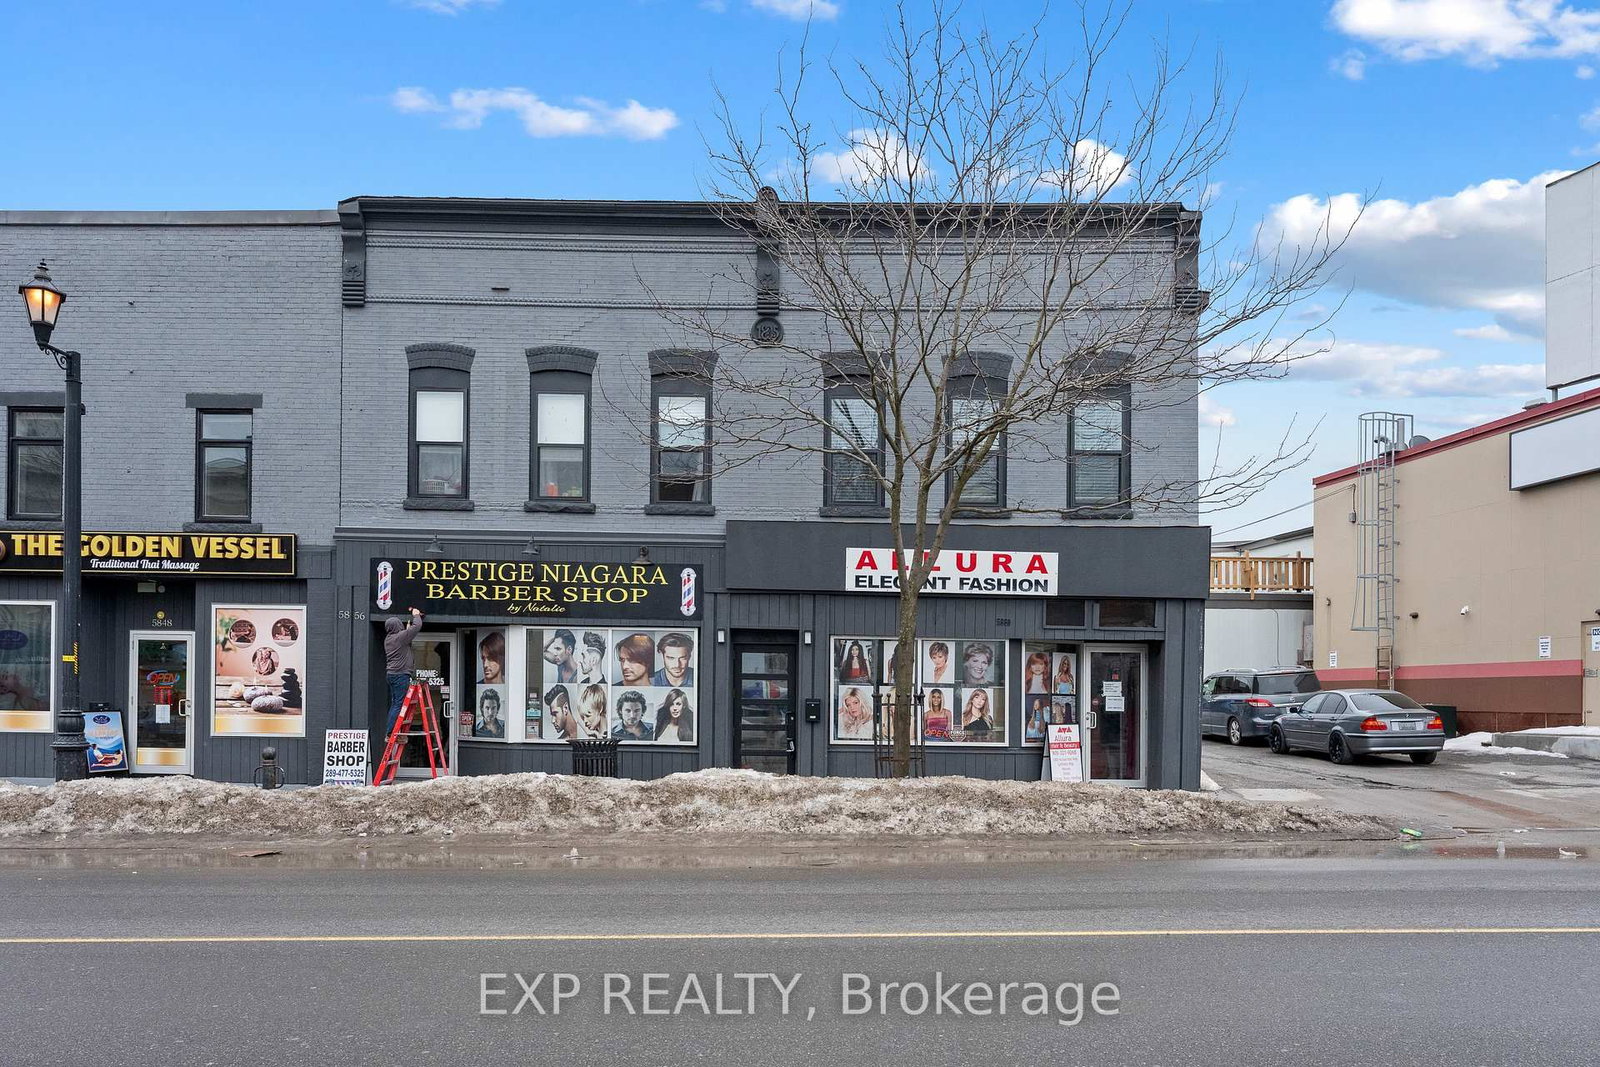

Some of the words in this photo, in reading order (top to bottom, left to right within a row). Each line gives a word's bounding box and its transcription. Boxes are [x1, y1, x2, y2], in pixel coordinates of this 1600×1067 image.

[11, 534, 64, 556] THE
[81, 534, 182, 558] GOLDEN
[191, 536, 287, 559] VESSEL
[90, 558, 139, 569] Traditional
[140, 559, 160, 570] Thai
[161, 560, 200, 572] Massage
[405, 560, 535, 583] PRESTIGE
[540, 563, 669, 585] NIAGARA
[854, 575, 951, 590] ELENT
[959, 577, 1048, 593] FASHION
[426, 583, 556, 603] BARBER
[563, 586, 649, 604] SHOP
[507, 603, 522, 615] by
[523, 602, 567, 614] Natalie
[338, 610, 350, 619] 58
[354, 611, 366, 621] 56
[151, 619, 173, 627] 5848
[150, 673, 178, 684] OPEN
[416, 669, 439, 678] PHONE:
[327, 732, 367, 740] PRESTIGE
[925, 729, 951, 738] OPEN
[327, 741, 365, 753] BARBER
[326, 755, 365, 767] SHOP
